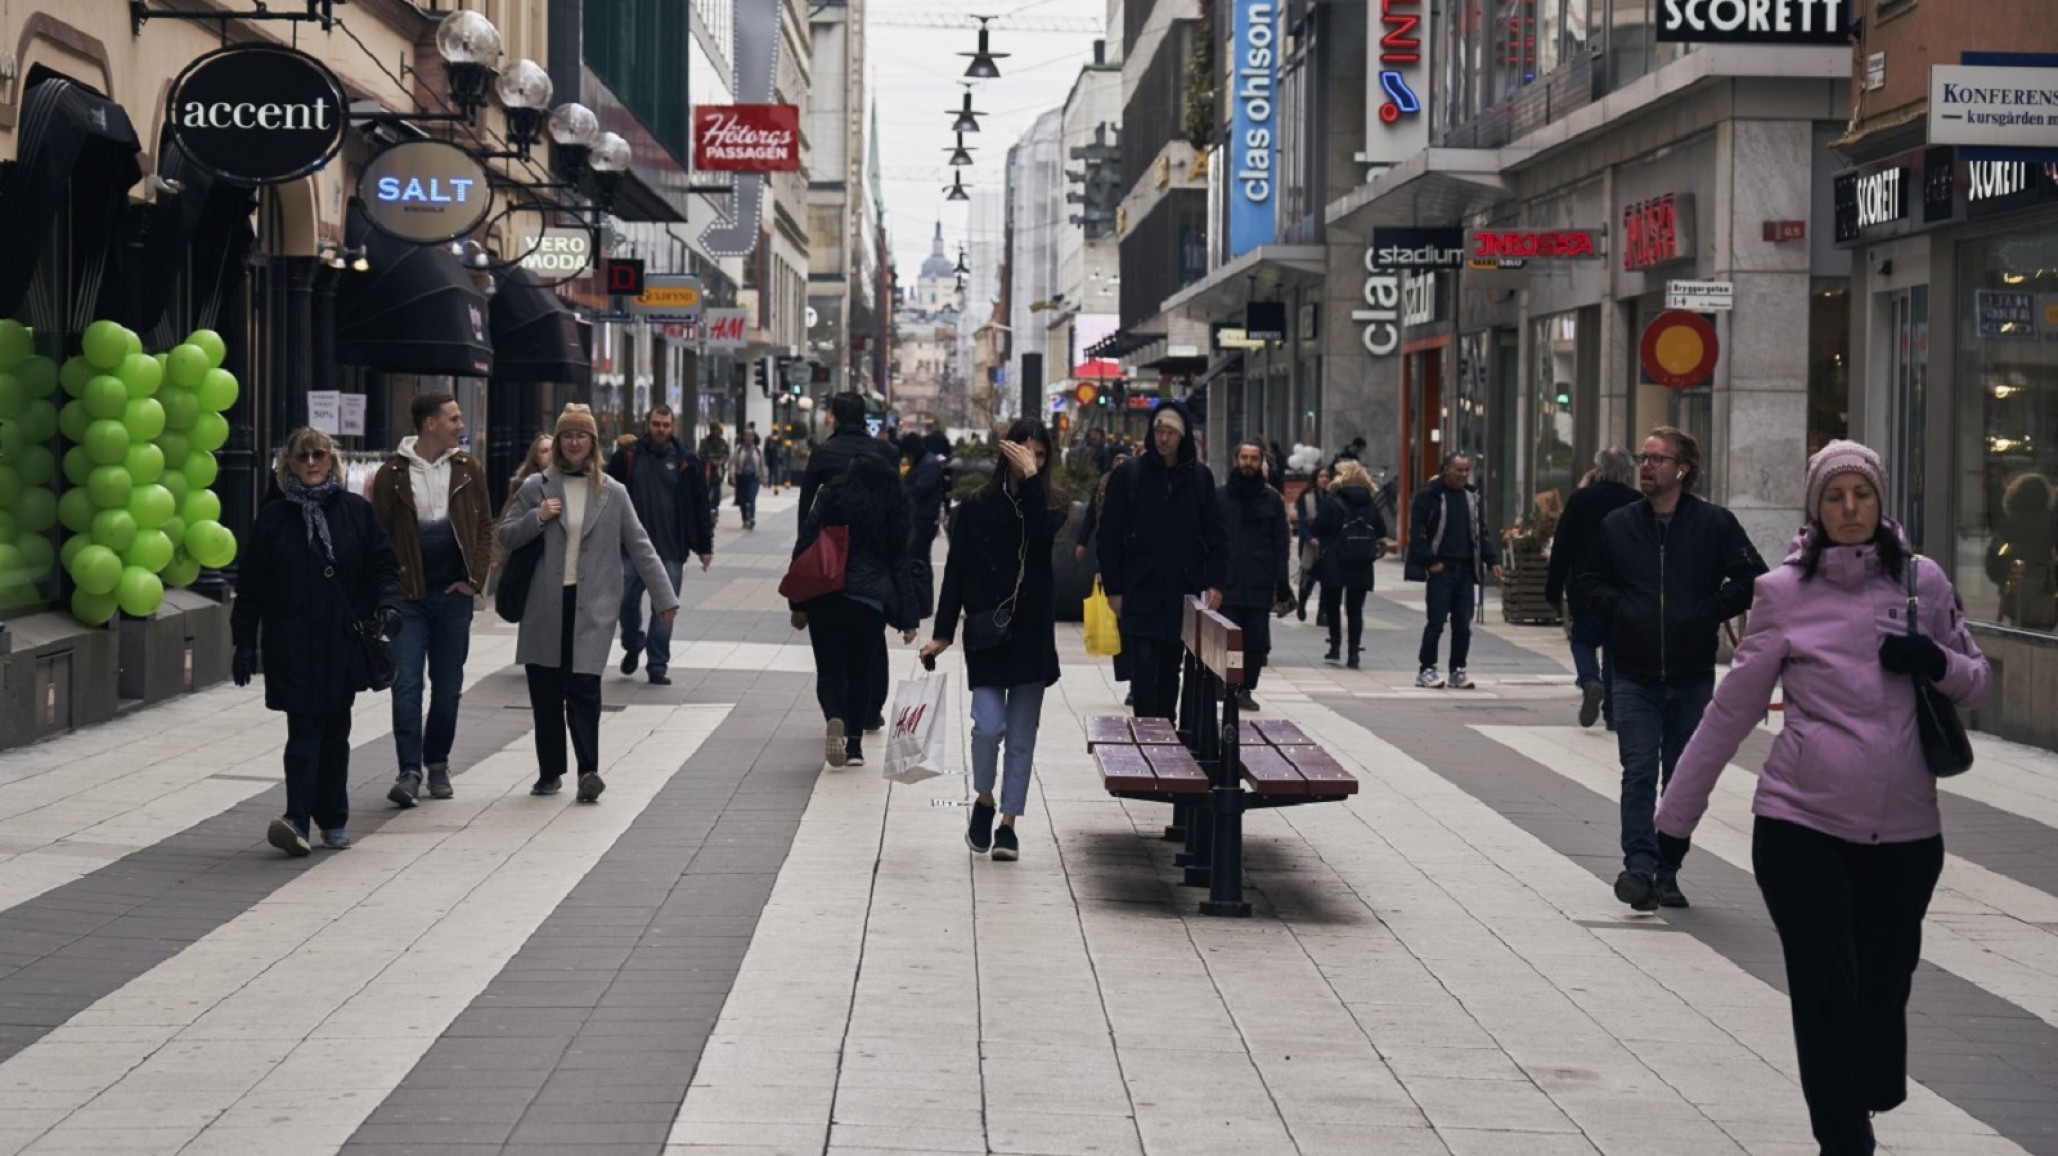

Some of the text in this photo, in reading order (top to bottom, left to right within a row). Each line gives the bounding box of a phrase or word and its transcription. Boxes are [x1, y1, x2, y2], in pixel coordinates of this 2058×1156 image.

[1664, 0, 1842, 33] SCORETT
[183, 97, 331, 131] accent
[1238, 3, 1272, 202] clas ohlson
[702, 113, 793, 147] Hötorgs
[1967, 109, 2044, 127] kursgården
[705, 146, 788, 159] PASSAGEN
[377, 176, 473, 202] SALT
[1856, 166, 1900, 228] SCORETT
[525, 236, 585, 252] VERO
[1377, 244, 1464, 264] stadium
[520, 253, 590, 270] MODA
[611, 264, 636, 290] D
[710, 316, 744, 340] H&M
[892, 703, 927, 739] H&M
